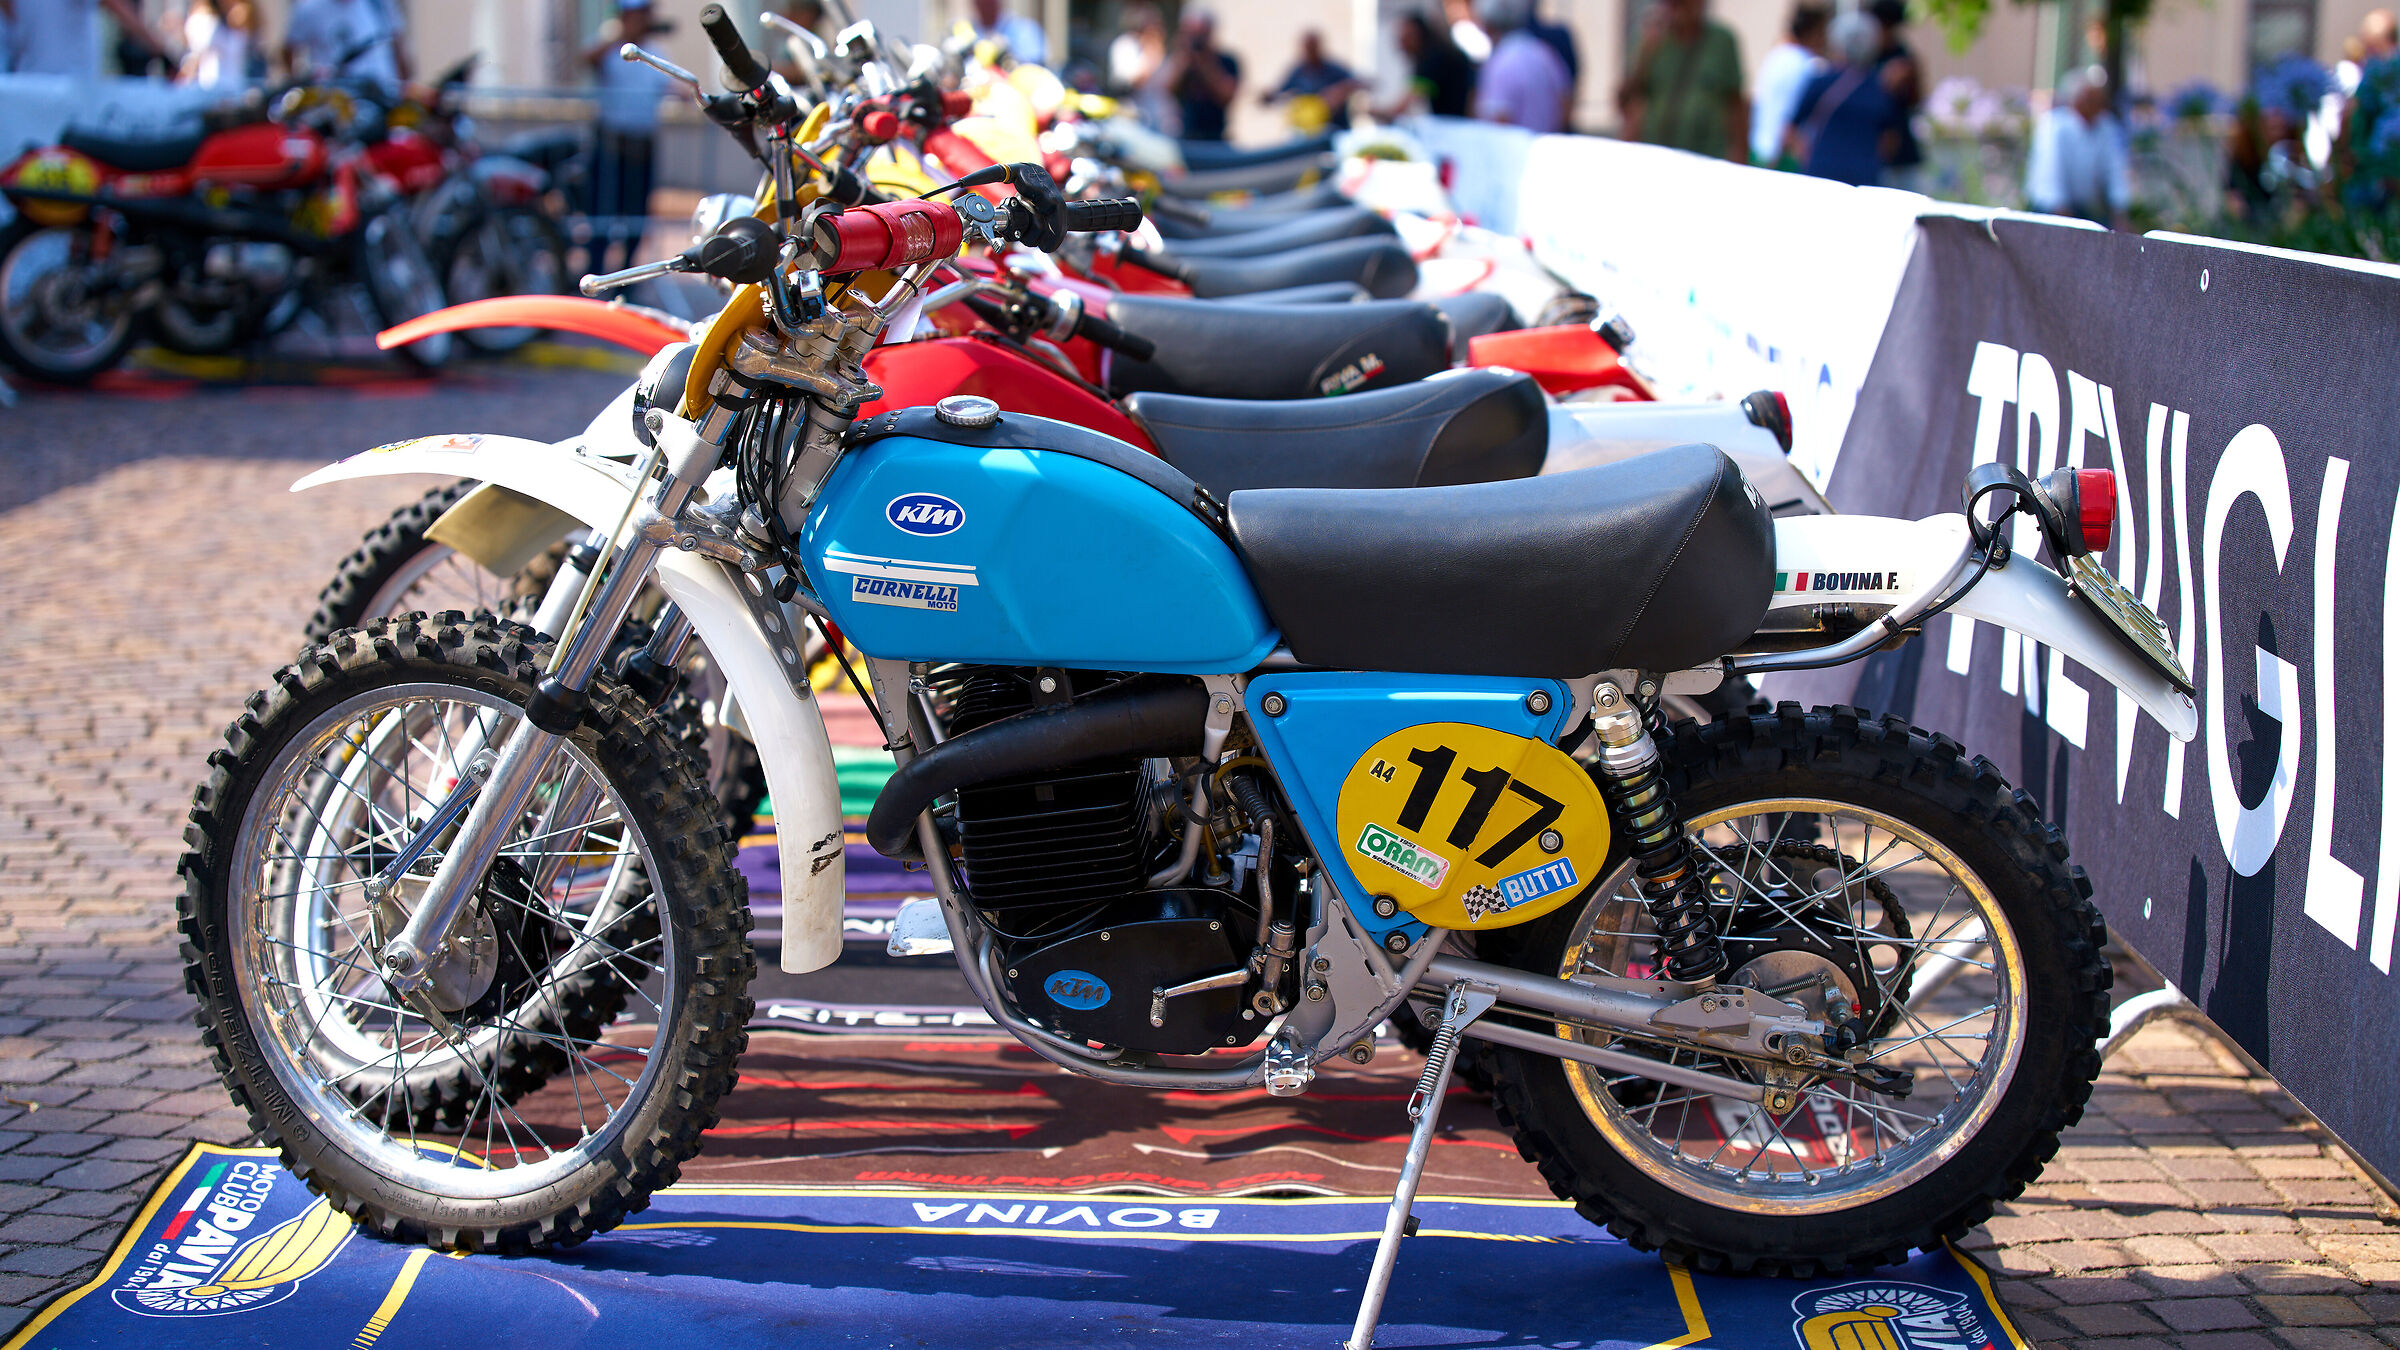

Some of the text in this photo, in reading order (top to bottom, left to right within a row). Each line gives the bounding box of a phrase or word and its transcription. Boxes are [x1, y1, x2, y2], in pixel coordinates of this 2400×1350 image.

[896, 503, 958, 526] KTM
[854, 577, 958, 603] CORNELLI
[1812, 571, 1899, 591] BOVINA F.
[927, 600, 957, 610] MOTO
[1370, 759, 1396, 783] A4
[1396, 744, 1566, 869] 117
[1366, 832, 1440, 880] ORAM
[1504, 861, 1574, 904] BUTTI
[1050, 977, 1105, 1001] KTM
[213, 1161, 259, 1208] CLUB
[239, 1163, 282, 1212] MOTO
[911, 1201, 1221, 1230] BOVINA
[147, 1201, 256, 1290] PAVIA
[122, 1243, 171, 1289] dal 1904
